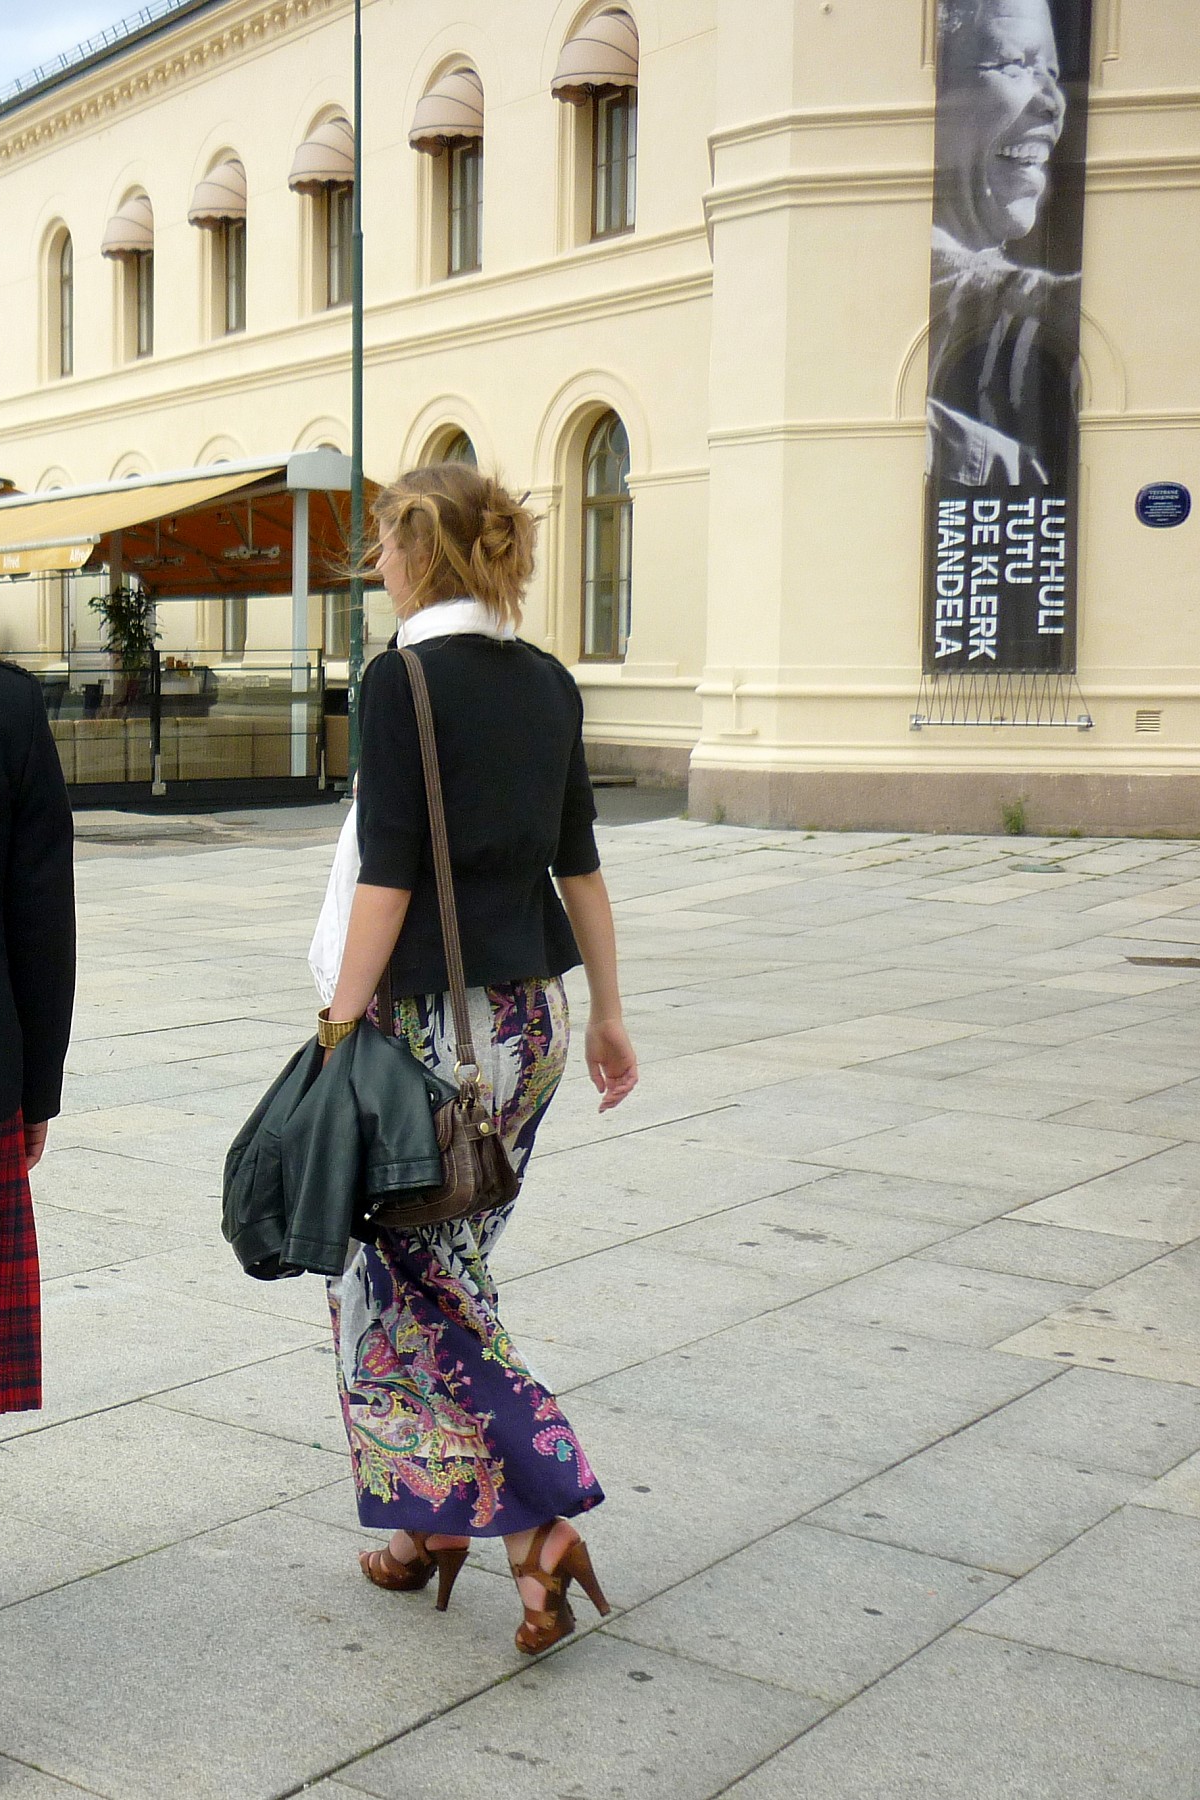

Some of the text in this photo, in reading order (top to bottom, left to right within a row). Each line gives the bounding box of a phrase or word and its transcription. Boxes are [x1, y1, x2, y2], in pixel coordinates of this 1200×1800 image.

[934, 499, 967, 660] MANDELA
[967, 499, 1001, 661] DE KLERK
[1004, 497, 1035, 585] TUTU
[1038, 499, 1066, 635] LUTHULI
